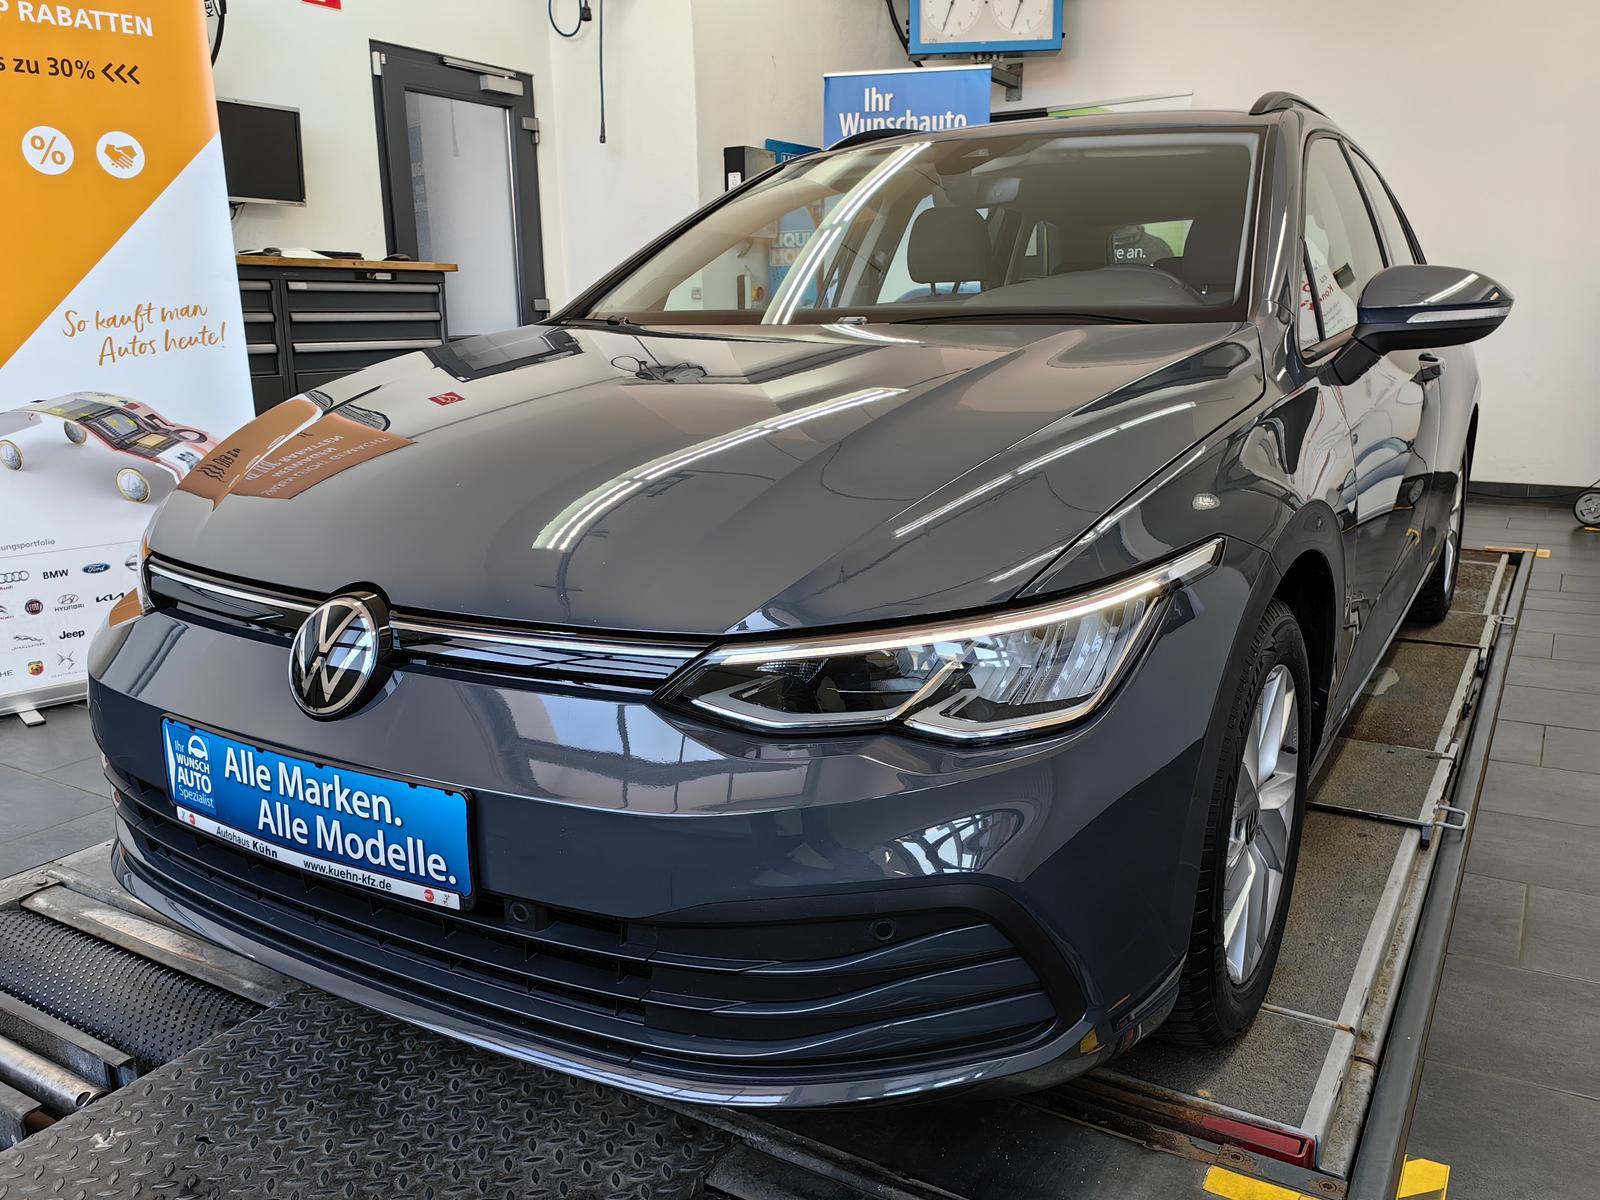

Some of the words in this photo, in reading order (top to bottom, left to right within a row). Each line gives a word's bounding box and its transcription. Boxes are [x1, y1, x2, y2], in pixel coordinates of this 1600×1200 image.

[17, 0, 153, 37] RABATTEN
[13, 58, 40, 75] zu
[47, 57, 95, 80] 30%
[864, 87, 894, 112] Ihr
[839, 110, 967, 137] Wunschauto
[1126, 247, 1147, 259] an.
[62, 310, 89, 337] So
[95, 302, 157, 333] kauft
[161, 303, 208, 322] man
[98, 336, 156, 366] Autos
[164, 321, 226, 352] heute!
[0, 539, 56, 551] ungsportfolio
[43, 569, 69, 580] BMW
[54, 603, 85, 612] HYUNDAI
[59, 630, 85, 640] Jeep
[175, 740, 185, 753] Ihr
[176, 752, 210, 775] WUNSCH
[178, 765, 212, 794] AUTO
[224, 747, 272, 792] Alle
[278, 762, 403, 827] Marken.
[178, 784, 215, 809] Spezialist
[216, 826, 251, 848] Autohaus
[252, 840, 278, 859] Kühn
[258, 799, 308, 845] Alle
[316, 815, 457, 885] Modelle.
[303, 859, 392, 891] www.kuehn-kfz.de
